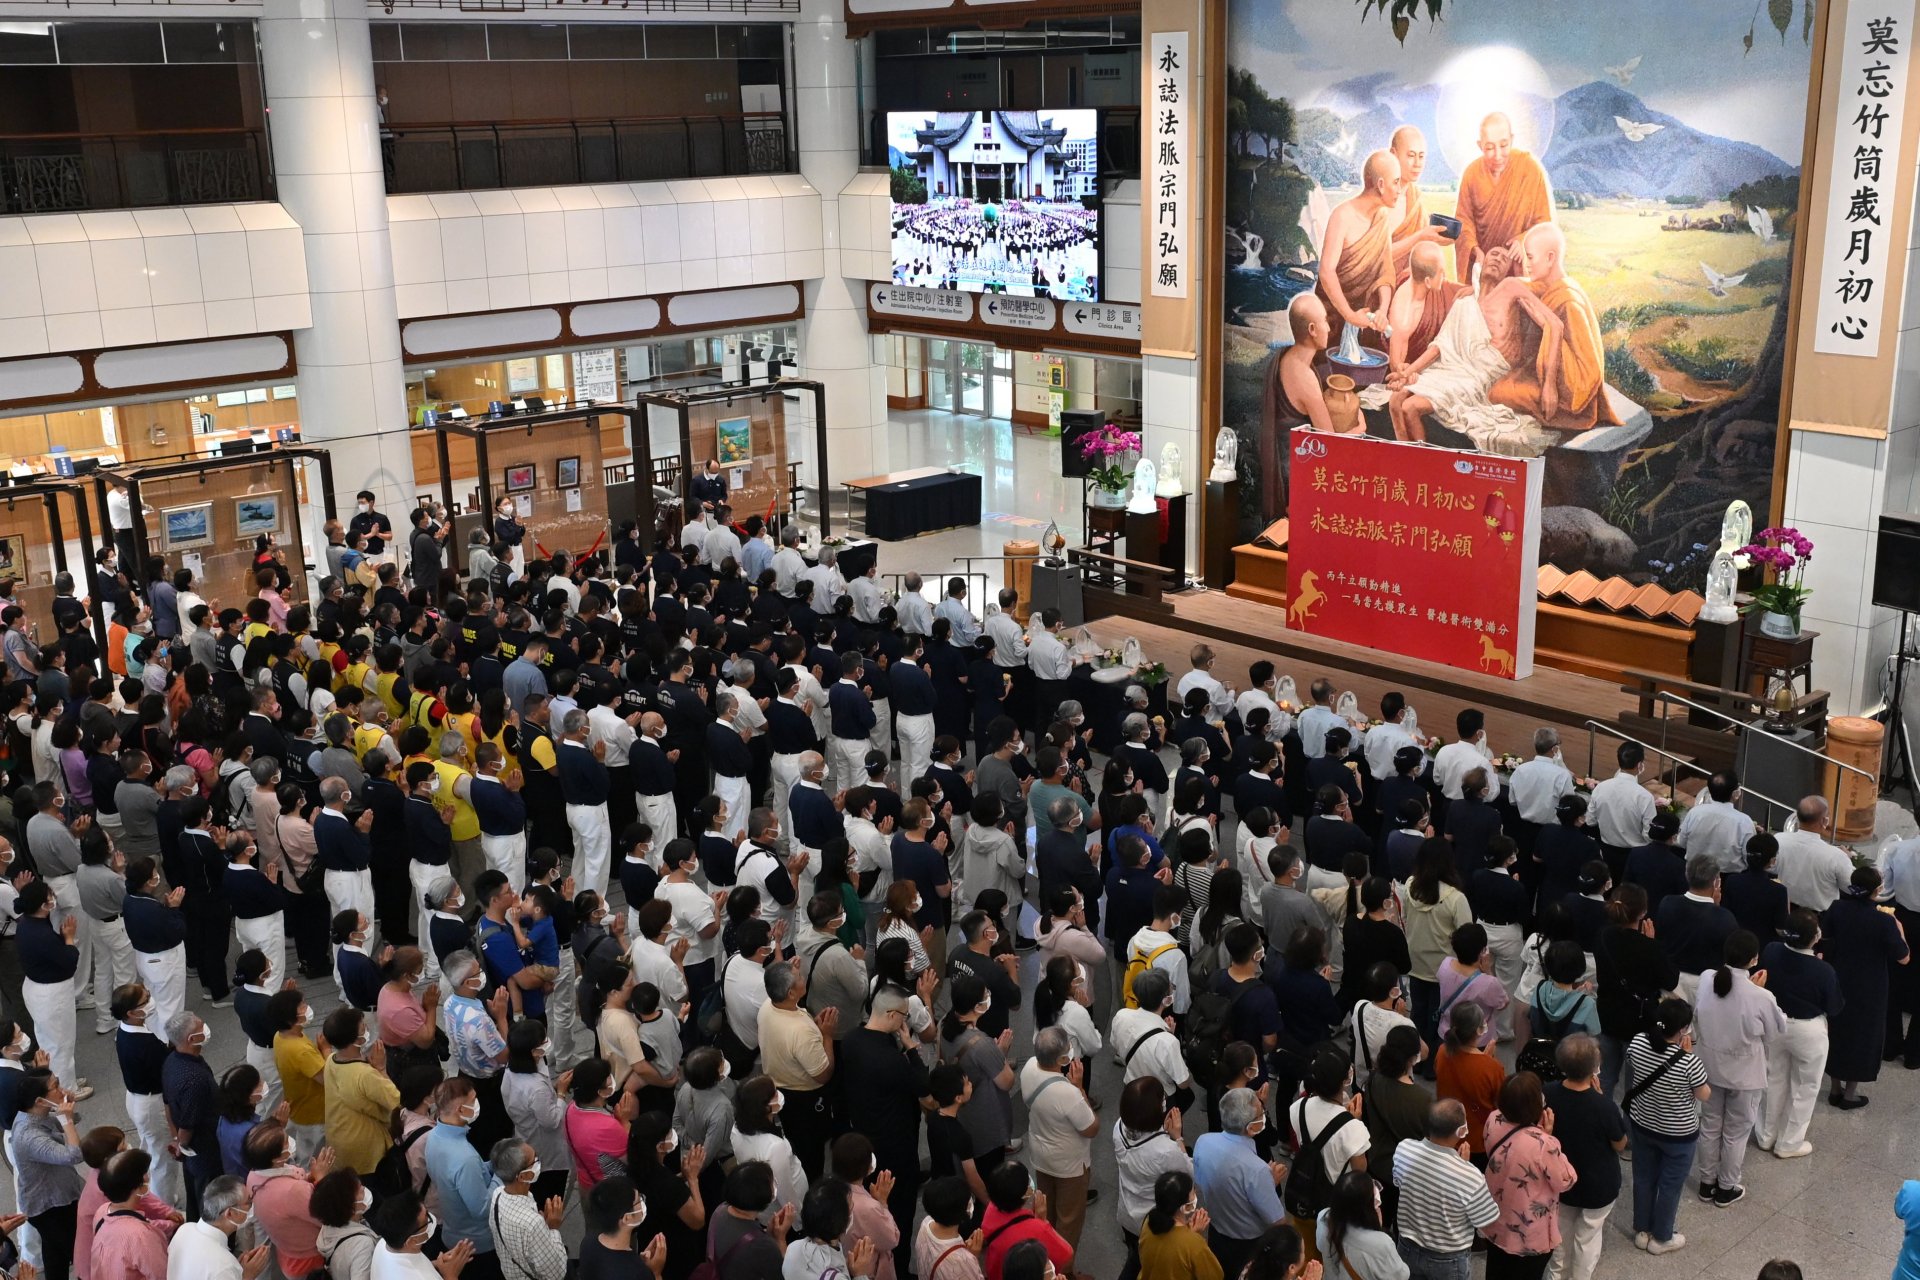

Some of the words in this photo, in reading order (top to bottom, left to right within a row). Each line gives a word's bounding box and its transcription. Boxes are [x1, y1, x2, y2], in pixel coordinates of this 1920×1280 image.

[1157, 44, 1180, 288] 永誌法脈宗門弘願
[1831, 16, 1899, 341] 莫忘竹筒歲月初心
[890, 289, 963, 307] 住出院中心/注射室
[1000, 298, 1045, 314] 預防醫學中心
[1091, 307, 1132, 323] 門診區
[1311, 466, 1476, 512] 莫忘竹筒歲月初心
[1310, 507, 1473, 559] 永誌法脈宗門弘願
[1326, 570, 1402, 597] 丙午立願勤精進
[1426, 608, 1510, 636] 醫德醫術雙滿分
[954, 960, 975, 977] PEANUTS
